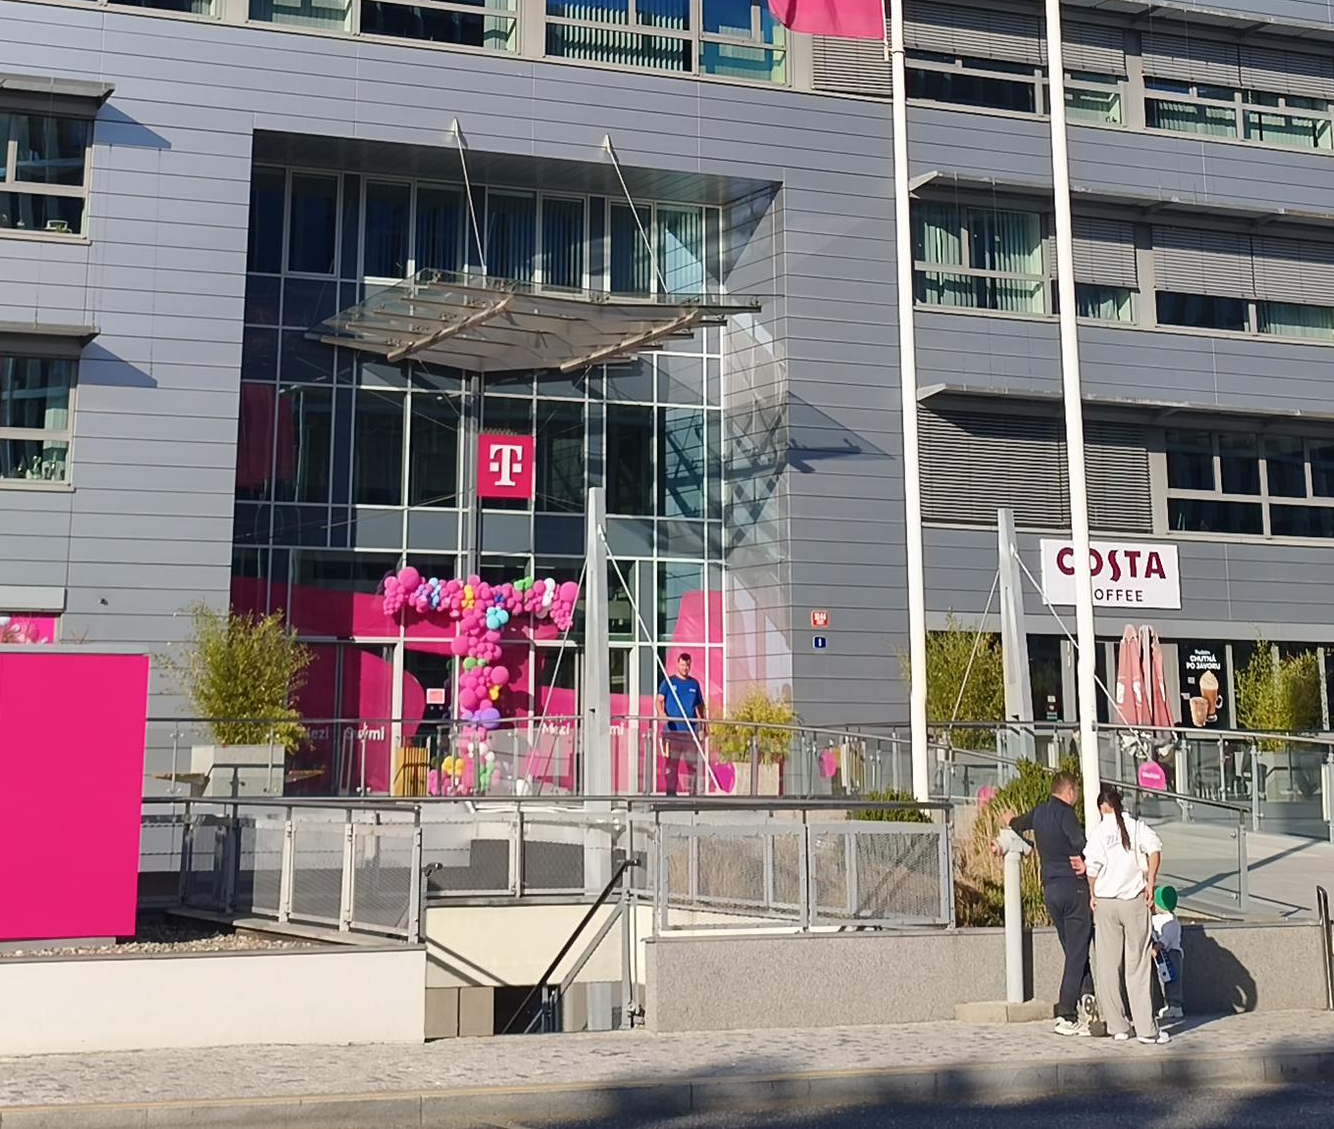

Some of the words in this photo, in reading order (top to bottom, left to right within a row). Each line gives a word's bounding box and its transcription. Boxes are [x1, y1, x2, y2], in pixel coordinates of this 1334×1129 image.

[489, 444, 523, 486] T
[1056, 546, 1167, 582] COSTA
[1093, 588, 1144, 602] OFFEE
